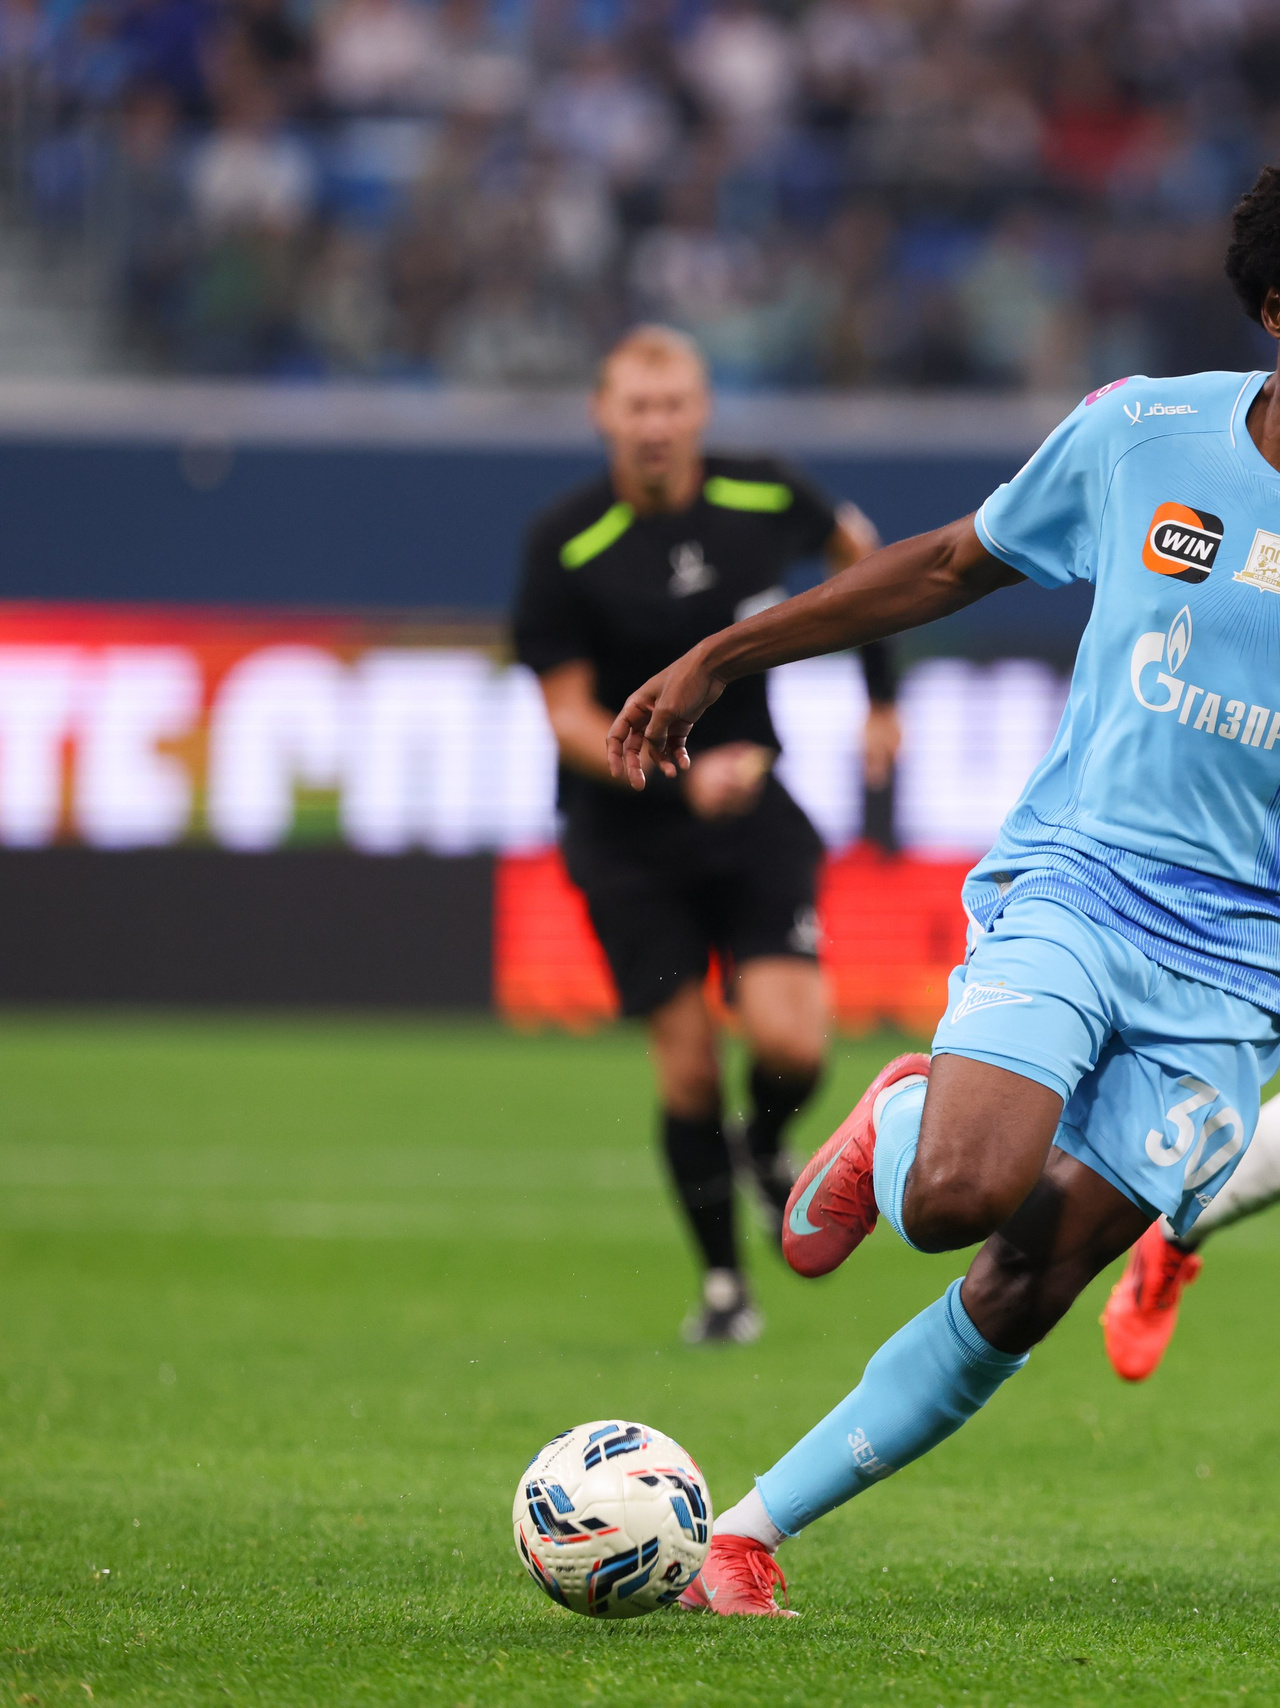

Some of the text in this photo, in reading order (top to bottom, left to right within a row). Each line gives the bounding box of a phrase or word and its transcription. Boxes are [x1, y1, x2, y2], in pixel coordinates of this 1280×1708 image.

[1143, 402, 1199, 417] JÖGEL
[1161, 528, 1215, 561] WIN
[1145, 1075, 1244, 1191] 30
[847, 1427, 890, 1475] ЗЕН
